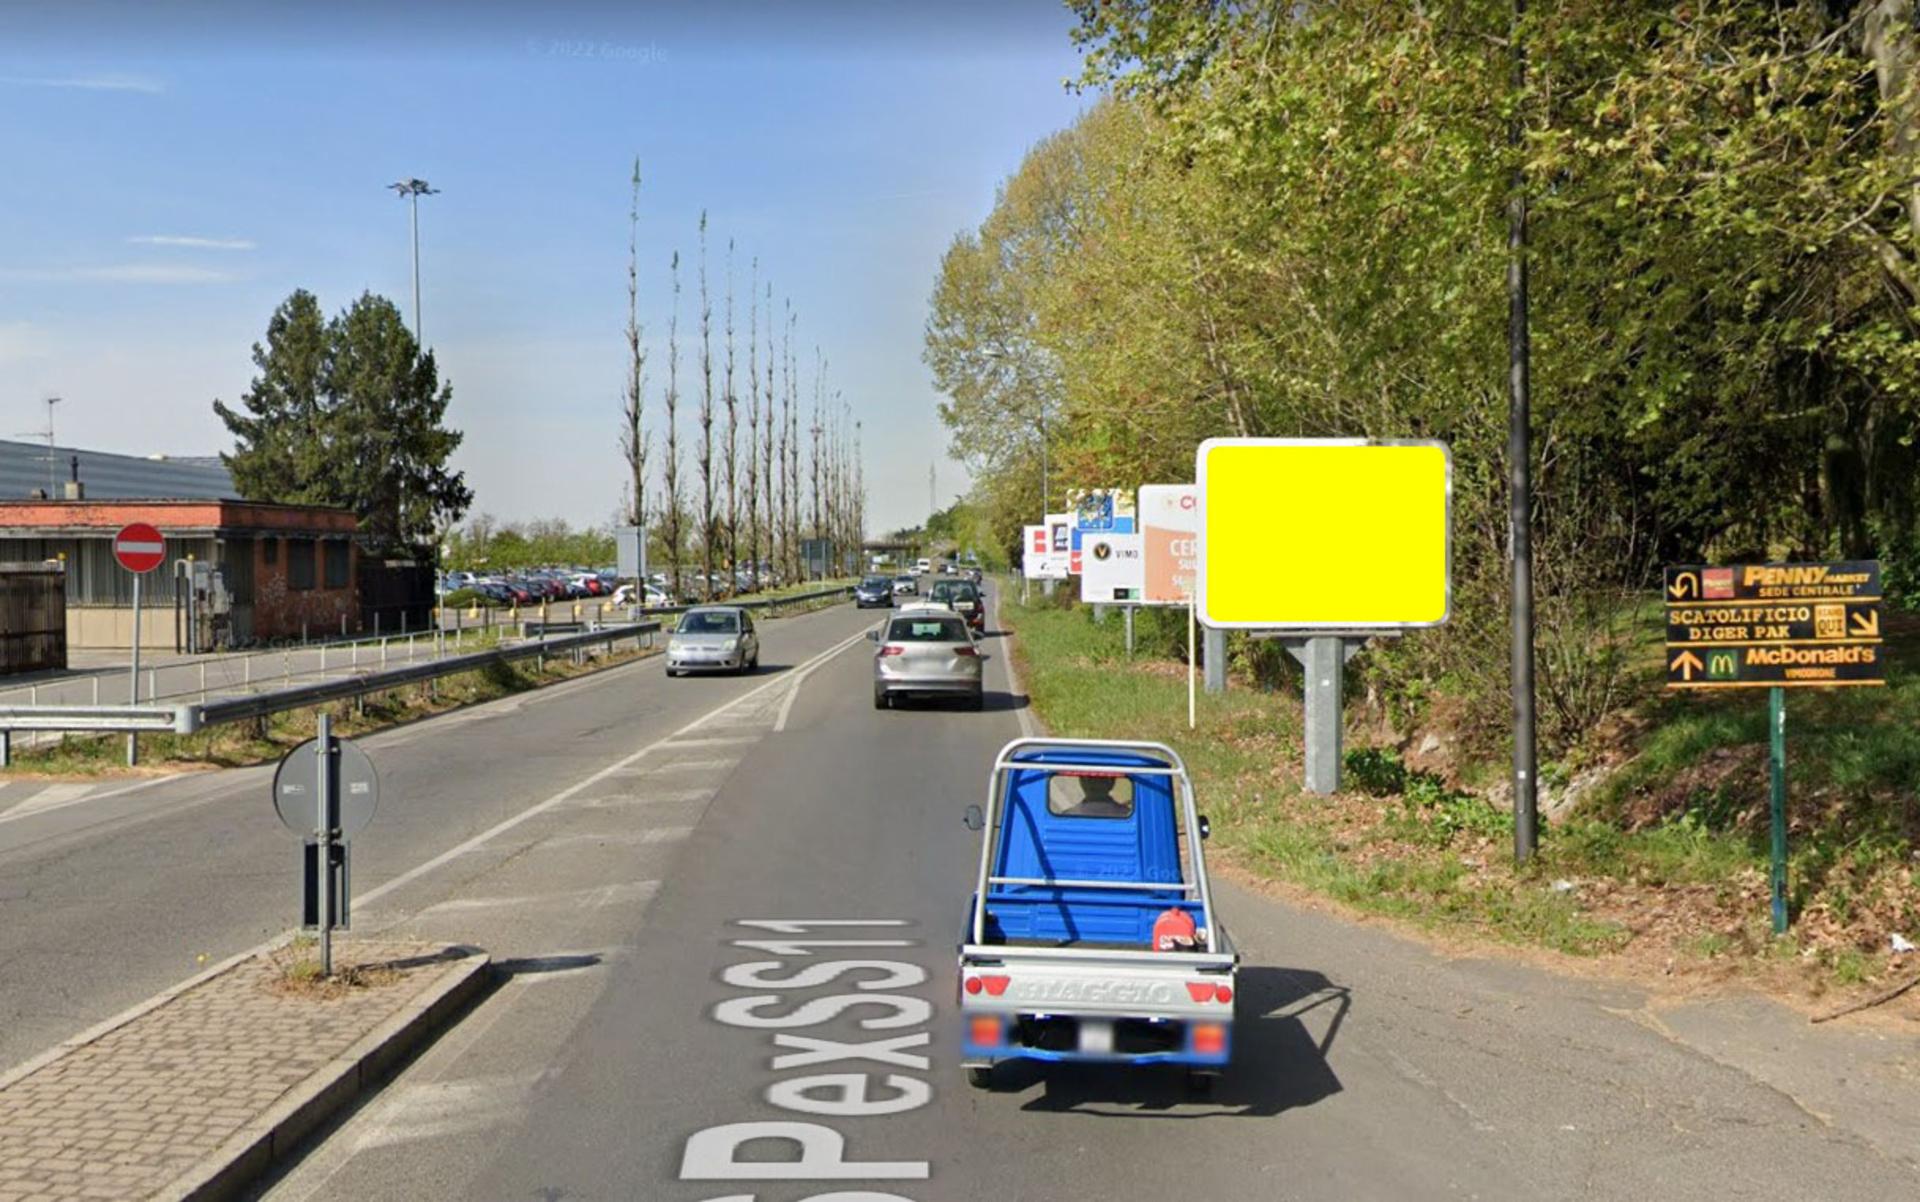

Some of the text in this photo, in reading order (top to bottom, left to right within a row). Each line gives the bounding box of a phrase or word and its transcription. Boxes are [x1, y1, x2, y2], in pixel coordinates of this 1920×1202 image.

[1744, 565, 1830, 586] PENNY
[1759, 585, 1854, 597] SEDE CENTRALE
[1669, 606, 1810, 625] SCATOLIFICIO
[1689, 625, 1791, 640] DIGER PAK
[1818, 618, 1843, 635] QUI
[1746, 645, 1876, 665] McDonald's
[679, 919, 931, 1202] PexSS11
